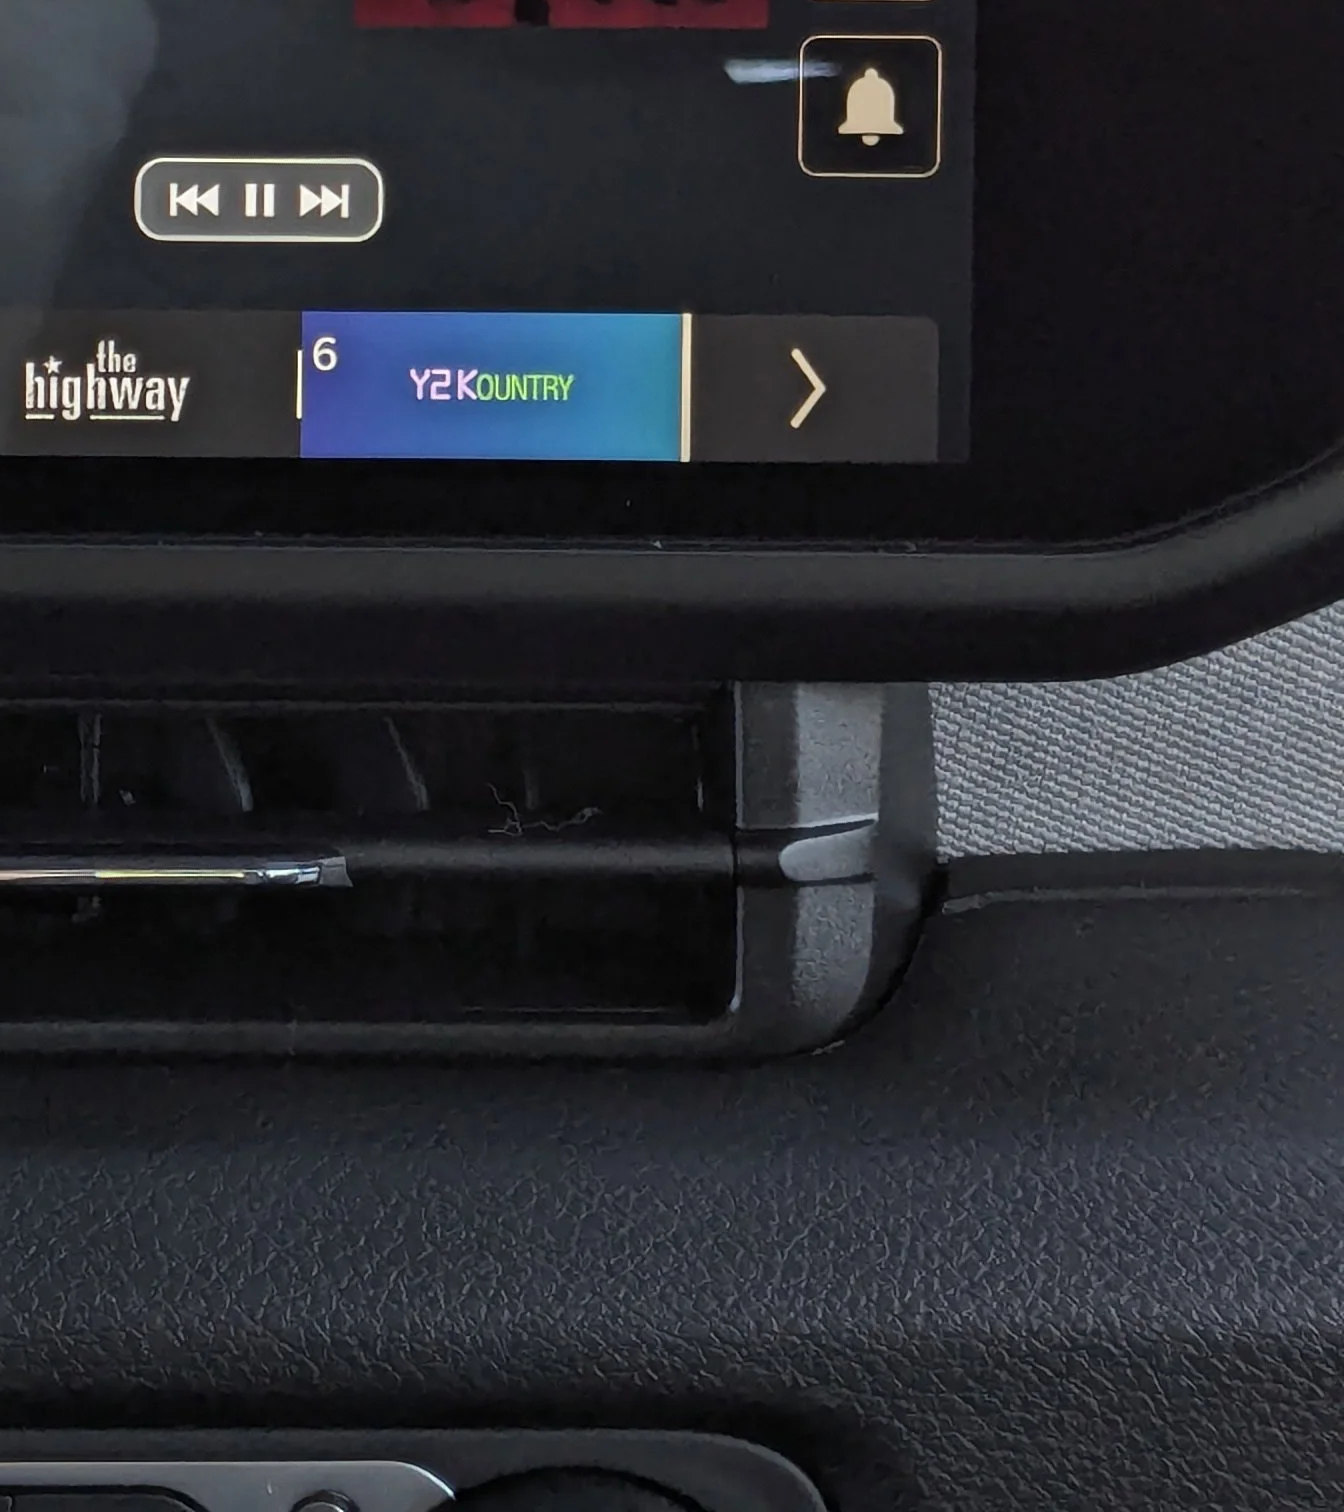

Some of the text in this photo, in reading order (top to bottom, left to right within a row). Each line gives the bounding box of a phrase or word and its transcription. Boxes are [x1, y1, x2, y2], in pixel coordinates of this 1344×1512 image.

[96, 339, 137, 373] the
[311, 336, 338, 372] 6
[25, 355, 191, 422] highway
